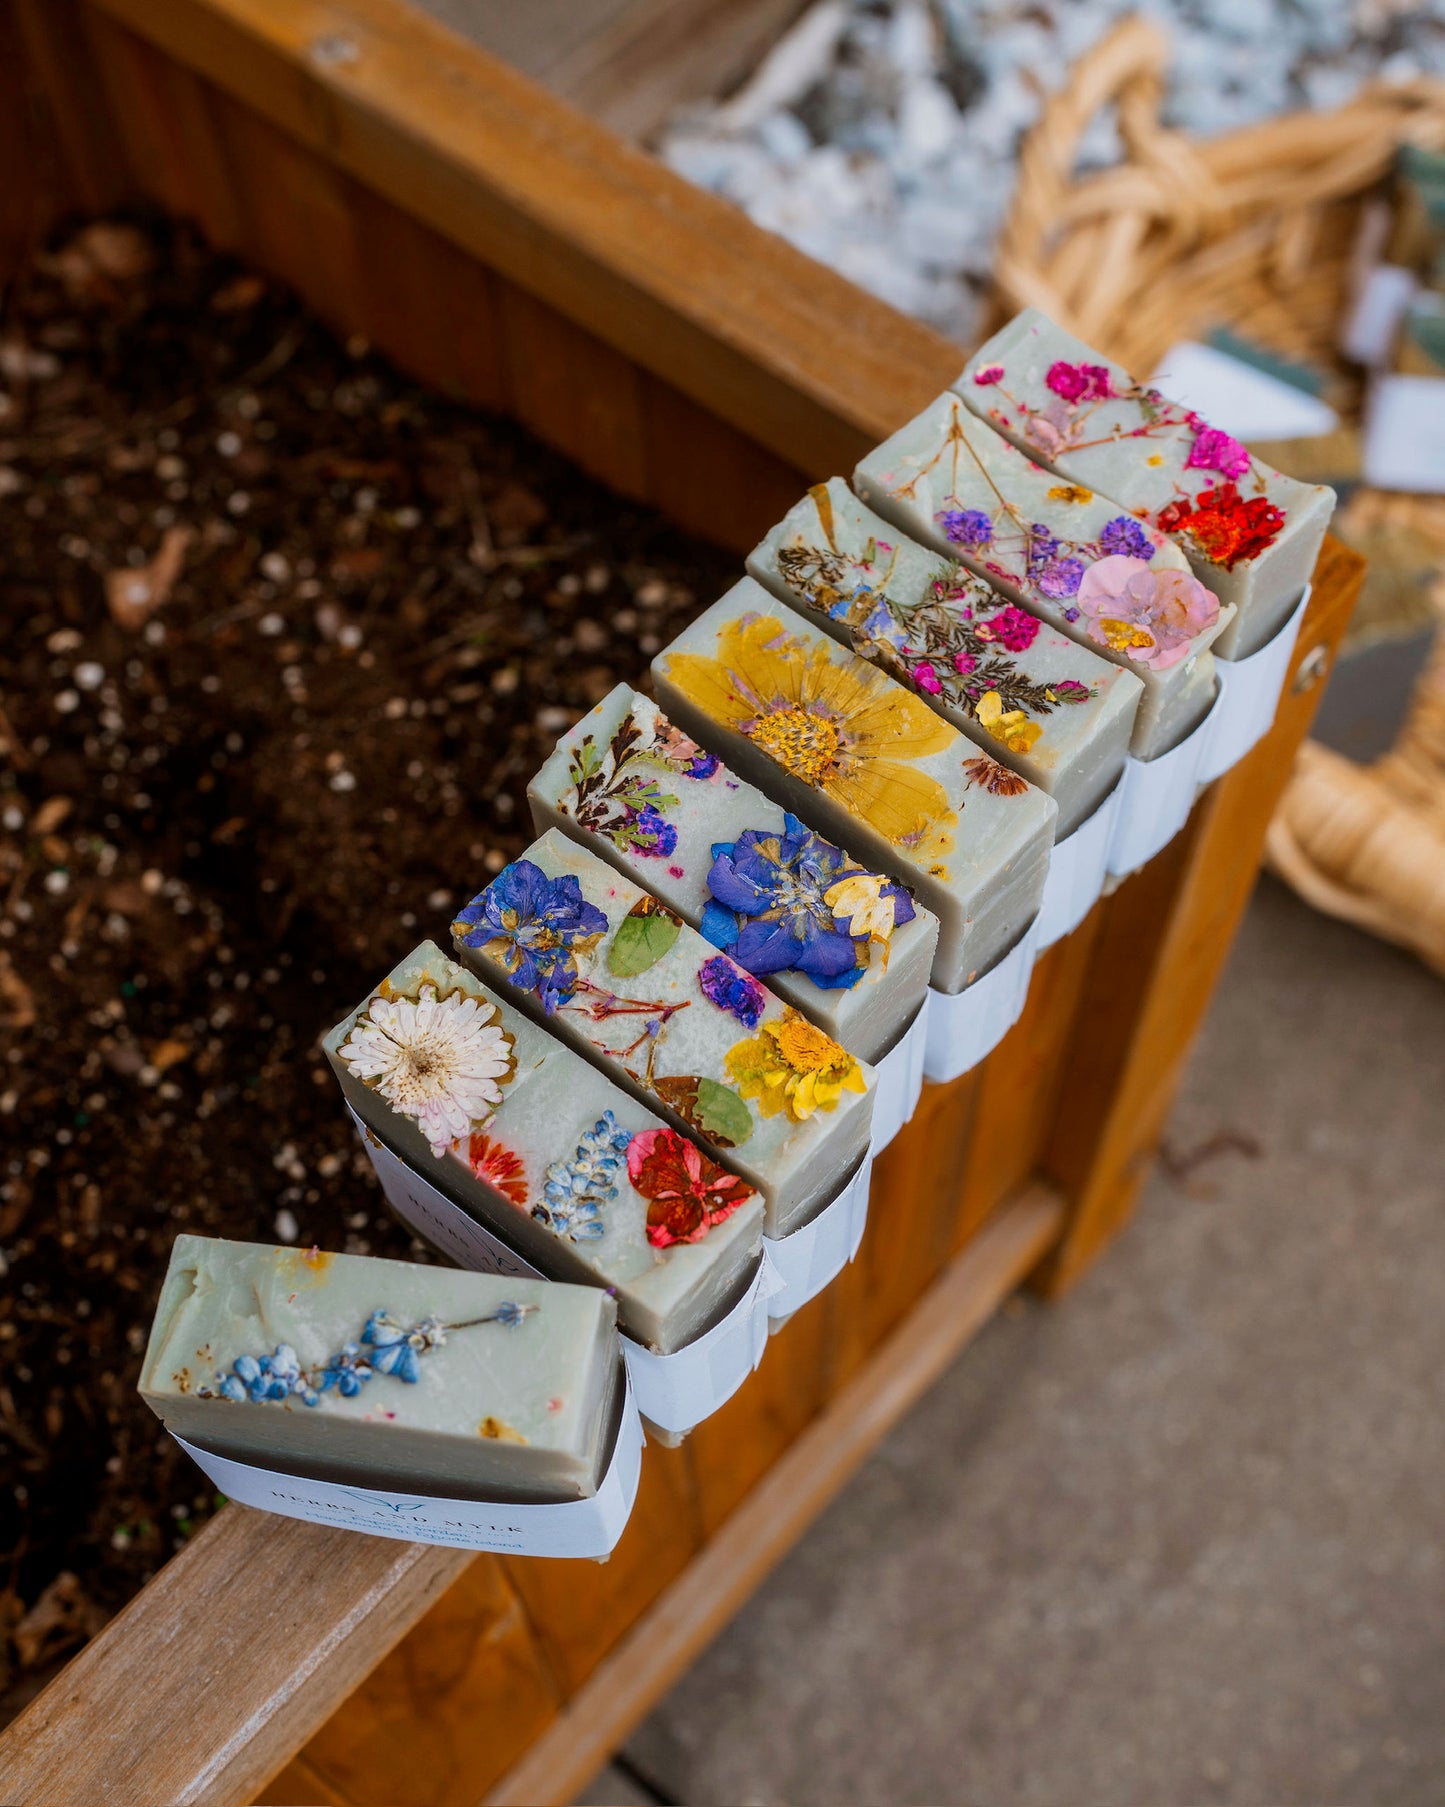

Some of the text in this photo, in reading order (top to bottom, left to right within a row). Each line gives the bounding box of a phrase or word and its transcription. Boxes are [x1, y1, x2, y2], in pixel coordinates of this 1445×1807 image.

[271, 1490, 523, 1533] HERBS AND MYLK
[304, 1511, 392, 1531] Handmade
[474, 1539, 524, 1549] Island
